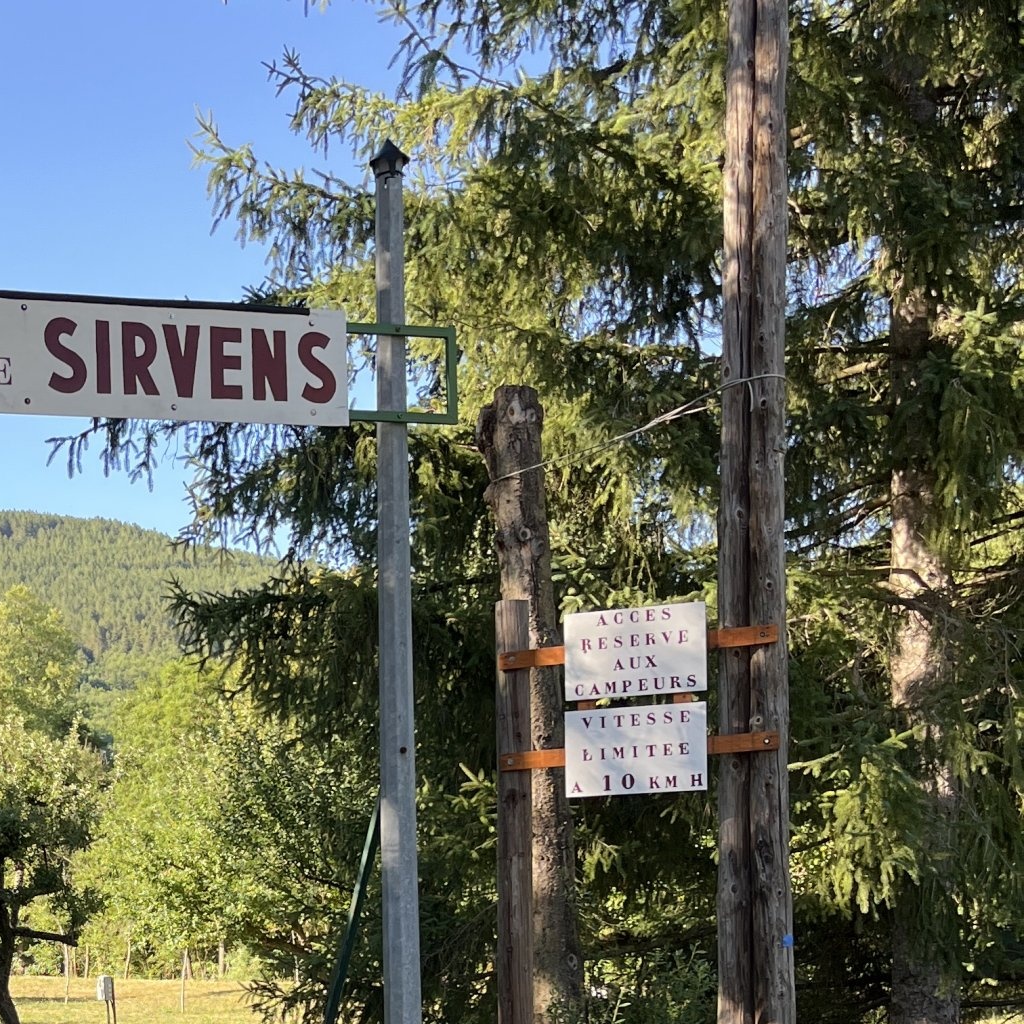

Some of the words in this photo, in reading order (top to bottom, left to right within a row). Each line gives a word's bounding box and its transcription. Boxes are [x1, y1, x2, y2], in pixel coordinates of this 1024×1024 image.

[43, 316, 338, 405] SIRVENS
[596, 608, 672, 627] ACCES
[580, 630, 689, 652] RESERVE
[613, 655, 658, 671] AUX
[575, 674, 697, 697] CAMPEURS
[581, 710, 691, 729] VITESSE
[582, 742, 690, 762] LIMITEE
[571, 782, 583, 794] A
[602, 773, 635, 791] 10
